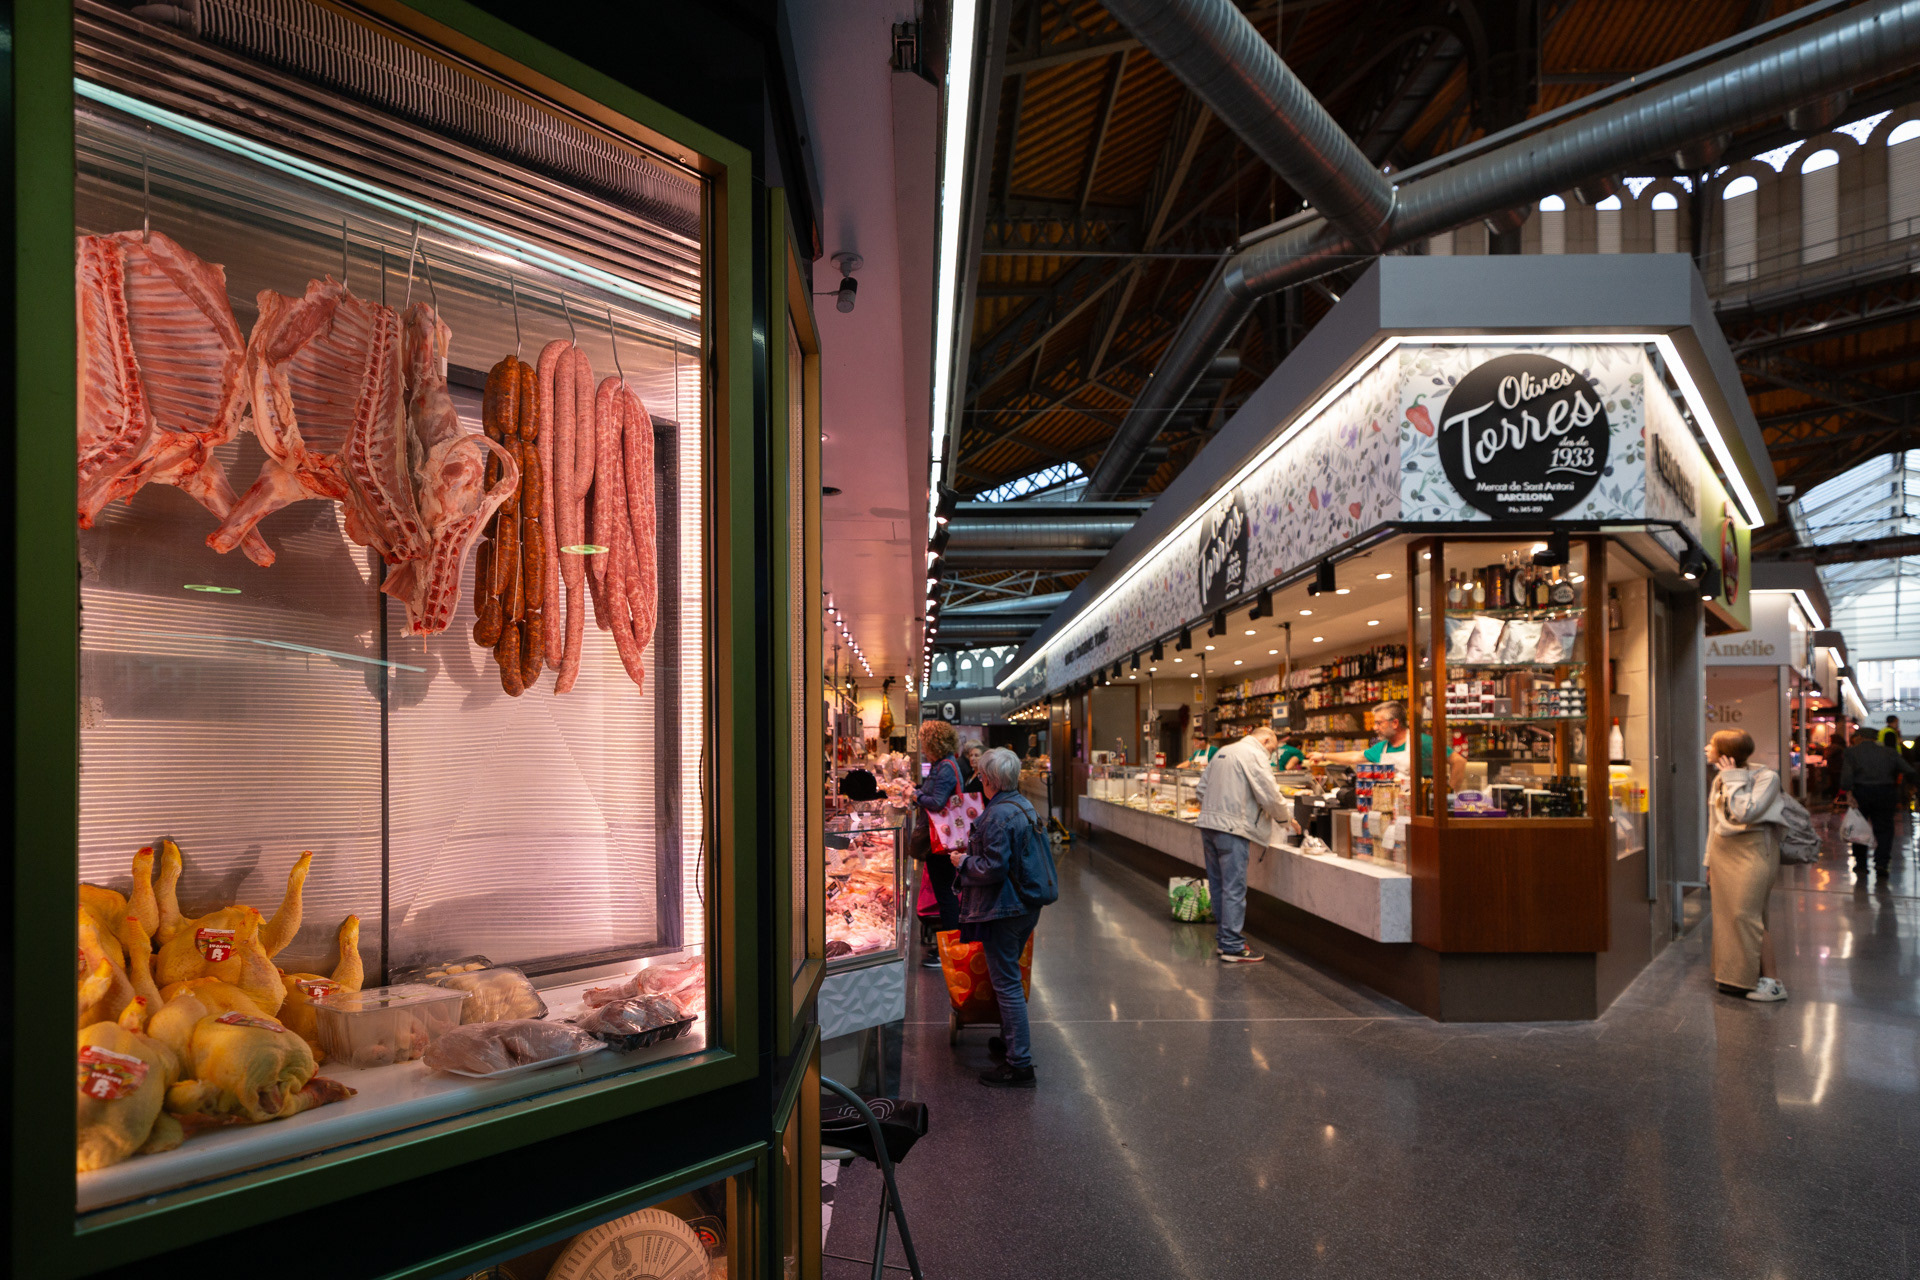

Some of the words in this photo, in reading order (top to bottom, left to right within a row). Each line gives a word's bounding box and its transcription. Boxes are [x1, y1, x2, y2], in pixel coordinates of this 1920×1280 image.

[1498, 368, 1576, 410] Olives
[1443, 390, 1601, 480] Torres
[1550, 447, 1595, 467] 1933
[1476, 482, 1508, 492] Mercat
[1508, 481, 1522, 492] de
[1523, 482, 1544, 492] Sant
[1544, 481, 1575, 492] Antoni
[1496, 493, 1555, 502] BARCELONA
[1706, 639, 1775, 657] Amélie
[653, 1236, 664, 1263] BEEMSTER
[661, 1240, 675, 1266] BEEMSTER
